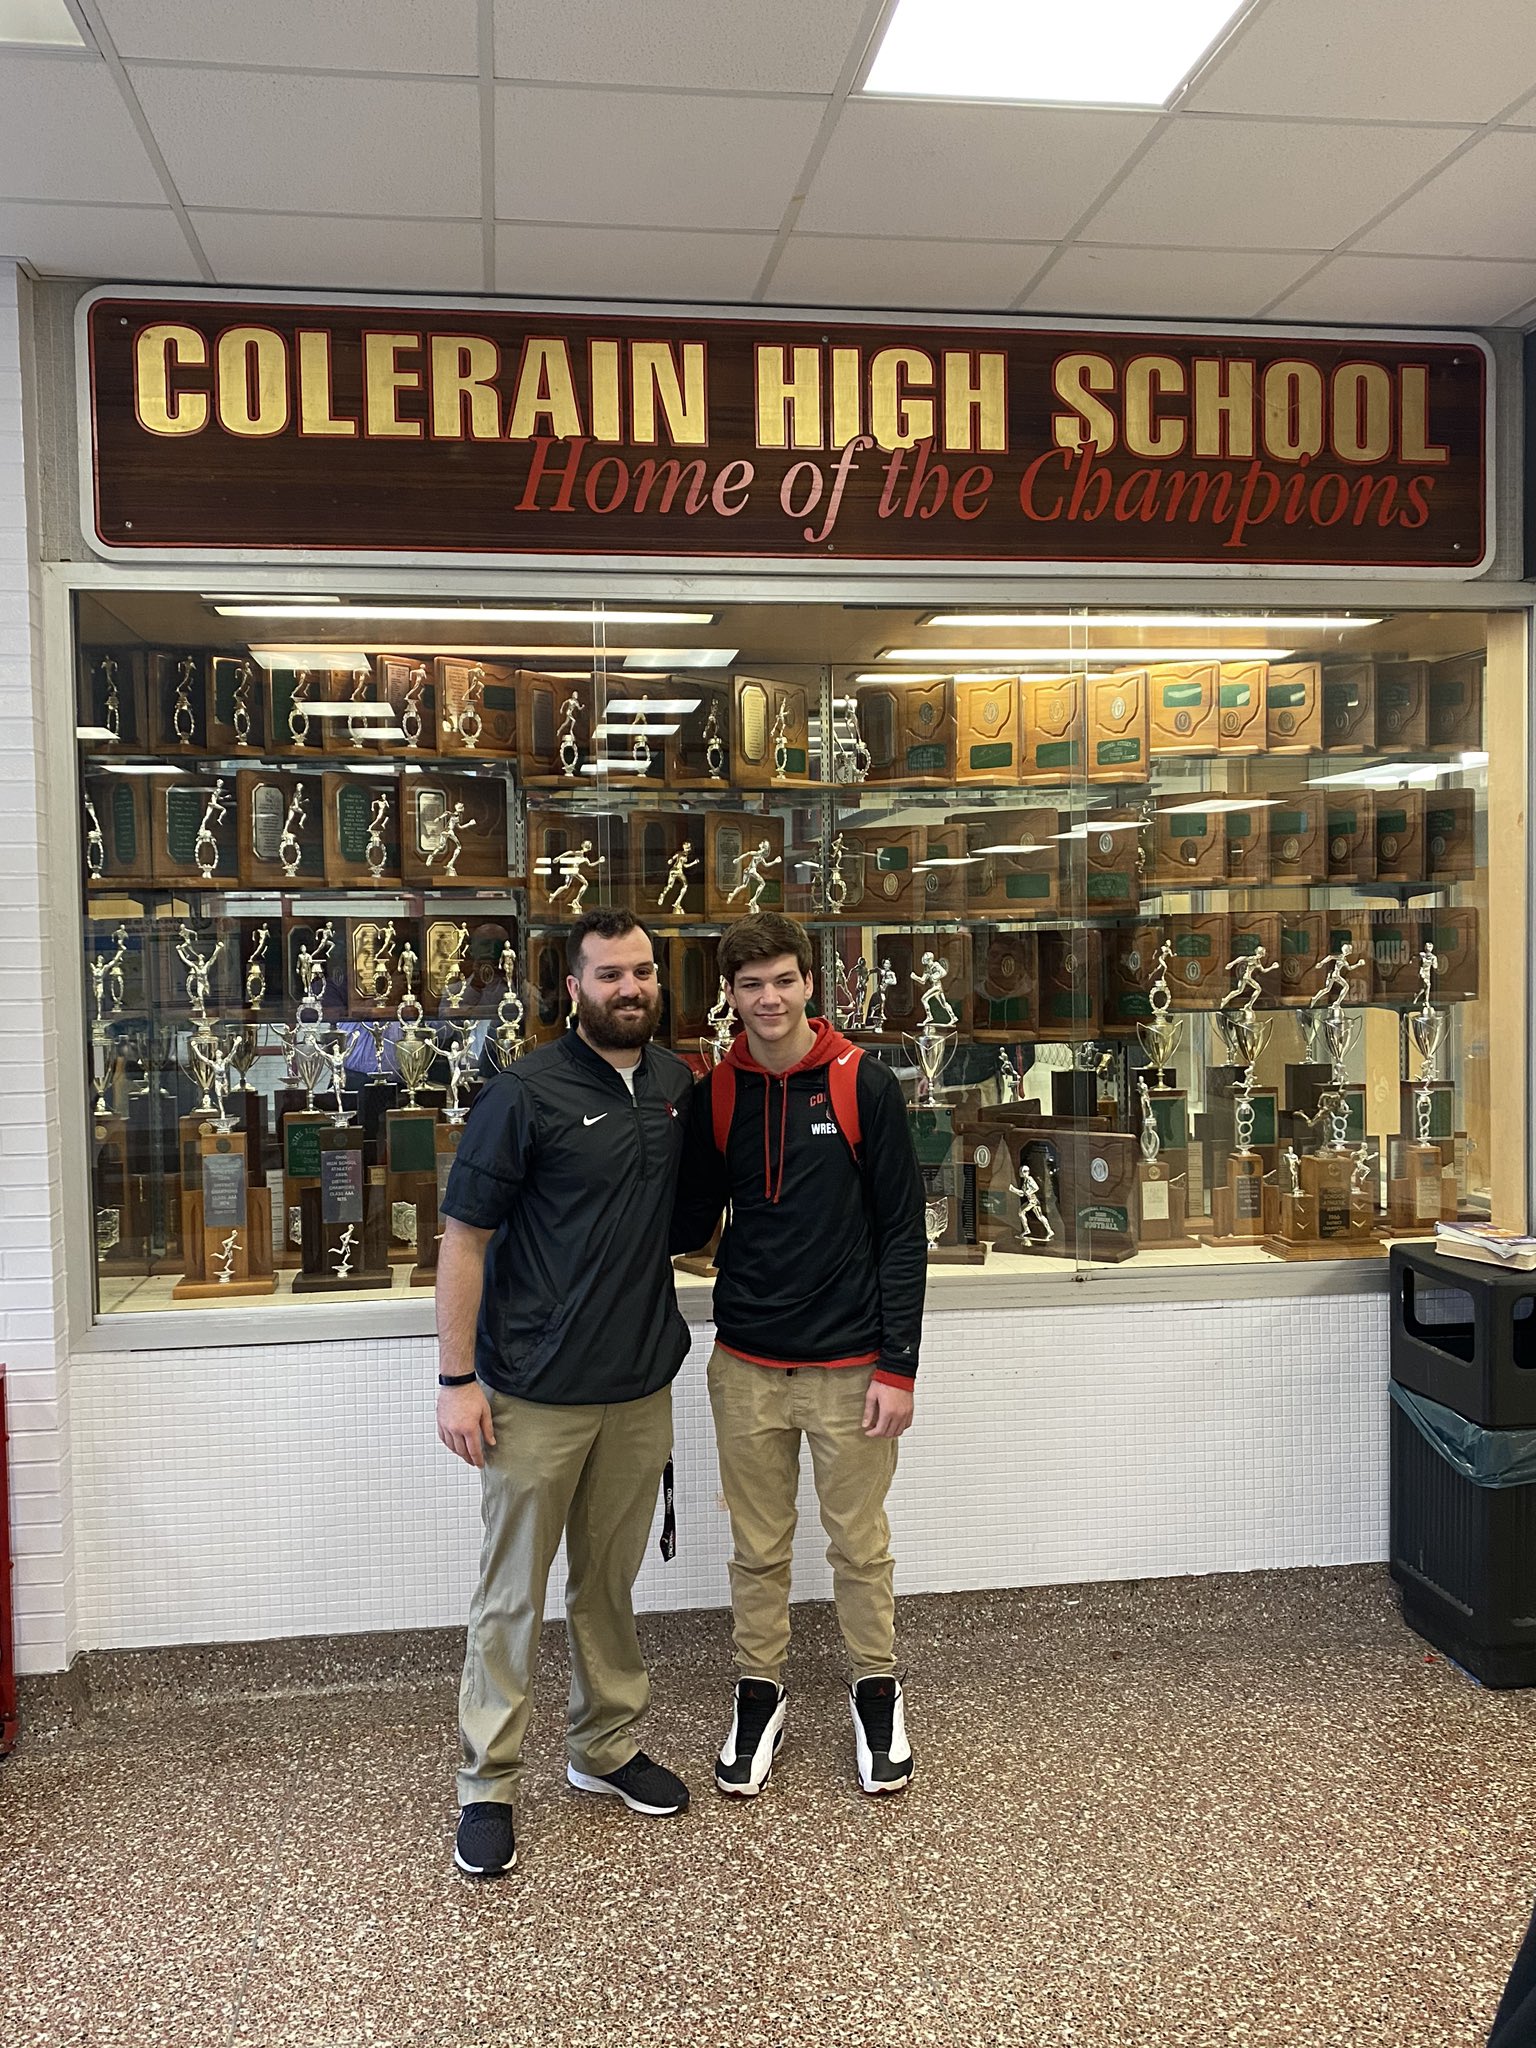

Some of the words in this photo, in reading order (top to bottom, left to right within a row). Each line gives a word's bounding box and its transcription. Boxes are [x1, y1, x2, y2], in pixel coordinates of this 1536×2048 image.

[134, 321, 709, 447] COLERAIN
[754, 342, 1009, 454] HIGH
[1052, 352, 1451, 465] SCHOOL
[514, 435, 753, 516] Home
[779, 435, 874, 543] of
[877, 437, 994, 521] the
[1019, 440, 1436, 548] Champions
[1084, 1221, 1119, 1231] FOOTBALL
